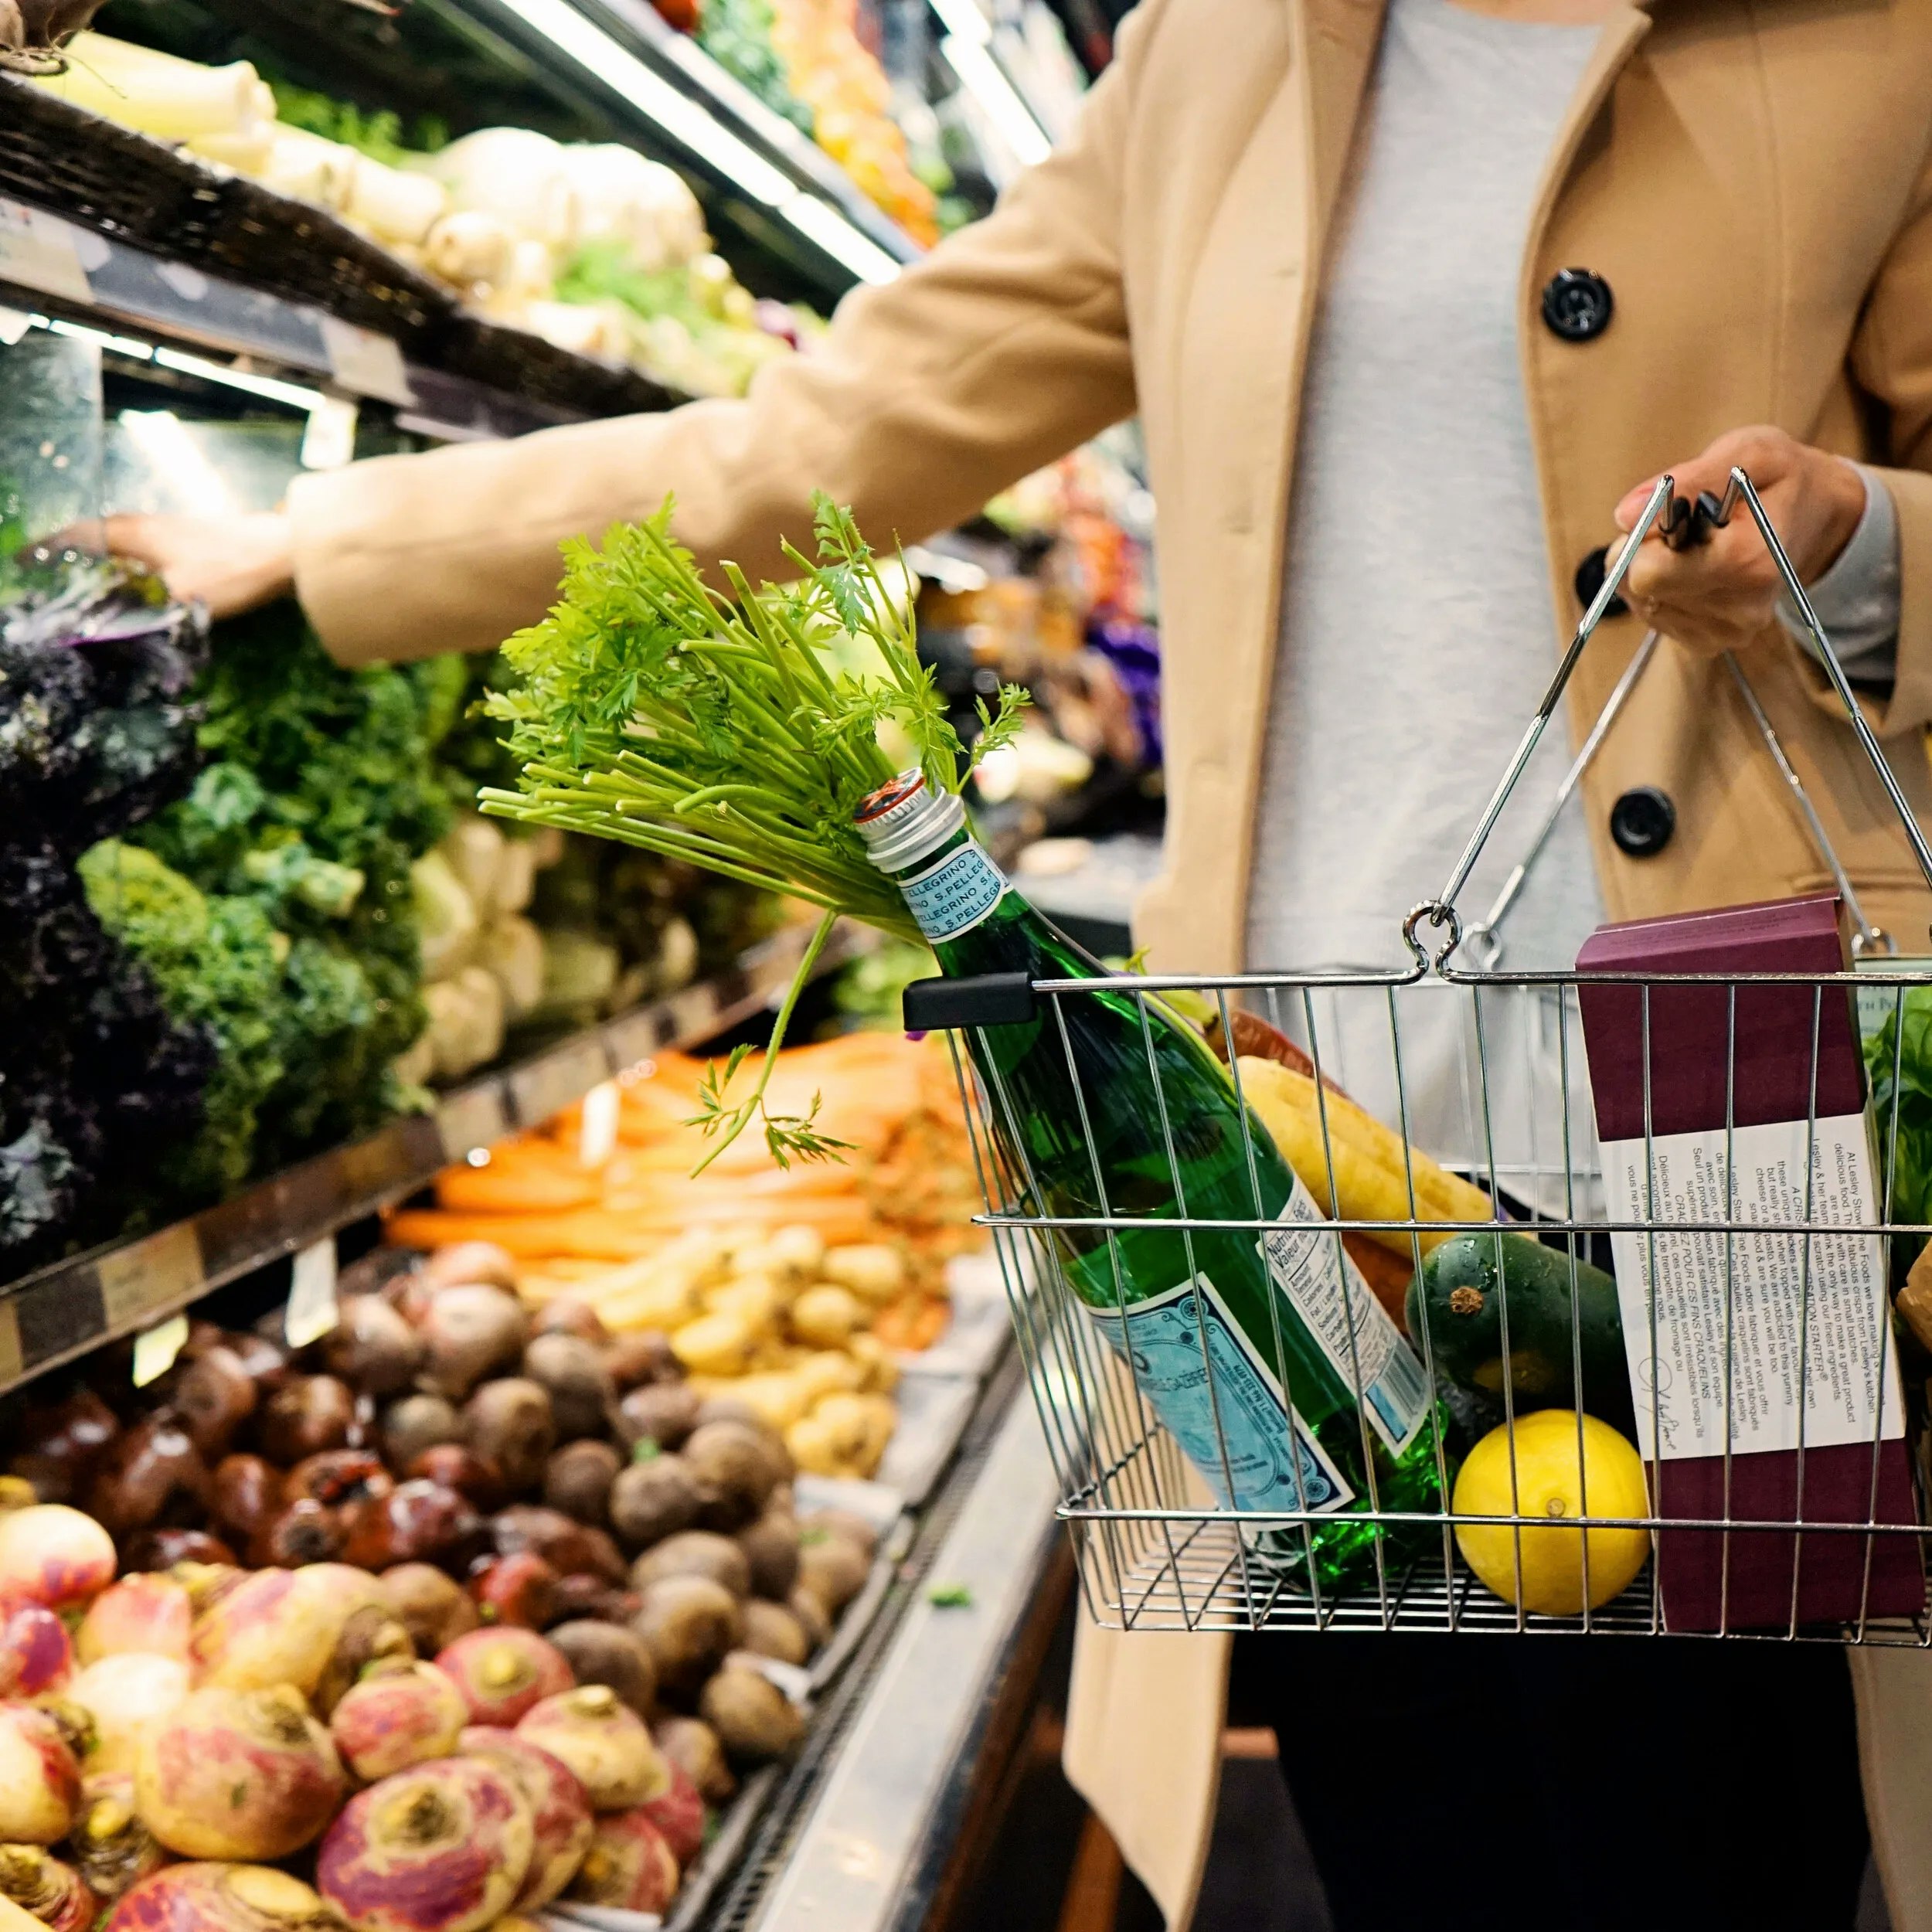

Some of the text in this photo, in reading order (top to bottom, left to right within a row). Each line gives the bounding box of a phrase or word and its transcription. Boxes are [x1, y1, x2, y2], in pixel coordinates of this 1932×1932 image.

[1692, 1147, 1702, 1168] Seul
[1846, 1151, 1855, 1162] At
[1696, 1172, 1702, 1183] un
[1755, 1168, 1765, 1202] cheese
[1766, 1167, 1776, 1182] but
[1777, 1161, 1786, 1186] these
[1848, 1165, 1859, 1196] Lesley
[1696, 1186, 1709, 1218] produit
[1768, 1185, 1779, 1209] really
[1817, 1182, 1825, 1199] her
[1627, 1165, 1635, 1187] vous
[1631, 1190, 1638, 1202] ne
[1635, 1242, 1646, 1261] plus
[1760, 1205, 1767, 1214] or
[1781, 1189, 1791, 1221] unique
[1819, 1200, 1828, 1224] team
[1274, 1238, 1301, 1269] Valeur
[1658, 1155, 1669, 1197] Délicieux
[1665, 1200, 1672, 1213] au
[1674, 1271, 1686, 1318] craquelins
[1681, 1321, 1691, 1341] sont
[1659, 1240, 1668, 1253] de
[1691, 1233, 1705, 1266] pouvait
[1776, 1240, 1785, 1264] when
[1814, 1240, 1825, 1274] scratch
[1835, 1242, 1846, 1261] with
[1715, 1152, 1723, 1164] de
[1732, 1274, 1742, 1312] fabuleux
[1737, 1315, 1750, 1362] craquelins
[1744, 1366, 1754, 1385] sont
[1740, 1253, 1750, 1282] Foods
[1768, 1264, 1777, 1276] We
[1826, 1252, 1835, 1267] the
[1860, 1253, 1871, 1283] Foods
[1706, 1162, 1714, 1183] avec
[1713, 1211, 1719, 1223] en
[1735, 1378, 1743, 1389] de
[1779, 1267, 1791, 1299] topped
[1828, 1270, 1838, 1290] only
[1834, 1143, 1876, 1413] delicious food. The fabulous crisps from Lesley's kitchen
[1838, 1264, 1847, 1284] care
[1698, 1267, 1709, 1309] satisfaire
[1744, 1285, 1753, 1311] adore
[1818, 1277, 1828, 1301] using
[1842, 1287, 1850, 1295] in
[1864, 1286, 1872, 1300] we
[1668, 1304, 1676, 1316] de
[1713, 1297, 1721, 1318] avec
[1784, 1302, 1794, 1320] with
[1831, 1291, 1839, 1311] way
[1843, 1298, 1854, 1323] small
[1866, 1301, 1875, 1321] love
[1682, 1248, 1709, 1399] POUR CES FINS CRAQUELINS
[1761, 1307, 1770, 1323] you
[1773, 1300, 1785, 1338] addicted
[1834, 1312, 1842, 1321] to
[1670, 1318, 1680, 1356] fromage
[1704, 1312, 1714, 1343] Lesley
[1716, 1321, 1724, 1338] des
[1748, 1315, 1759, 1355] fabriquer
[1765, 1326, 1774, 1340] will
[1785, 1323, 1795, 1343] your
[1824, 1321, 1835, 1346] finest
[1835, 1325, 1845, 1349] make
[1708, 1345, 1716, 1354] et
[1767, 1343, 1776, 1354] be
[1778, 1342, 1787, 1351] to
[1869, 1324, 1880, 1358] making
[1675, 1359, 1682, 1371] ou
[1754, 1358, 1763, 1367] et
[1780, 1353, 1789, 1369] this
[1838, 1361, 1851, 1385] great
[1781, 1372, 1792, 1405] yummy
[1807, 1389, 1815, 1409] own
[1842, 1387, 1855, 1423] product
